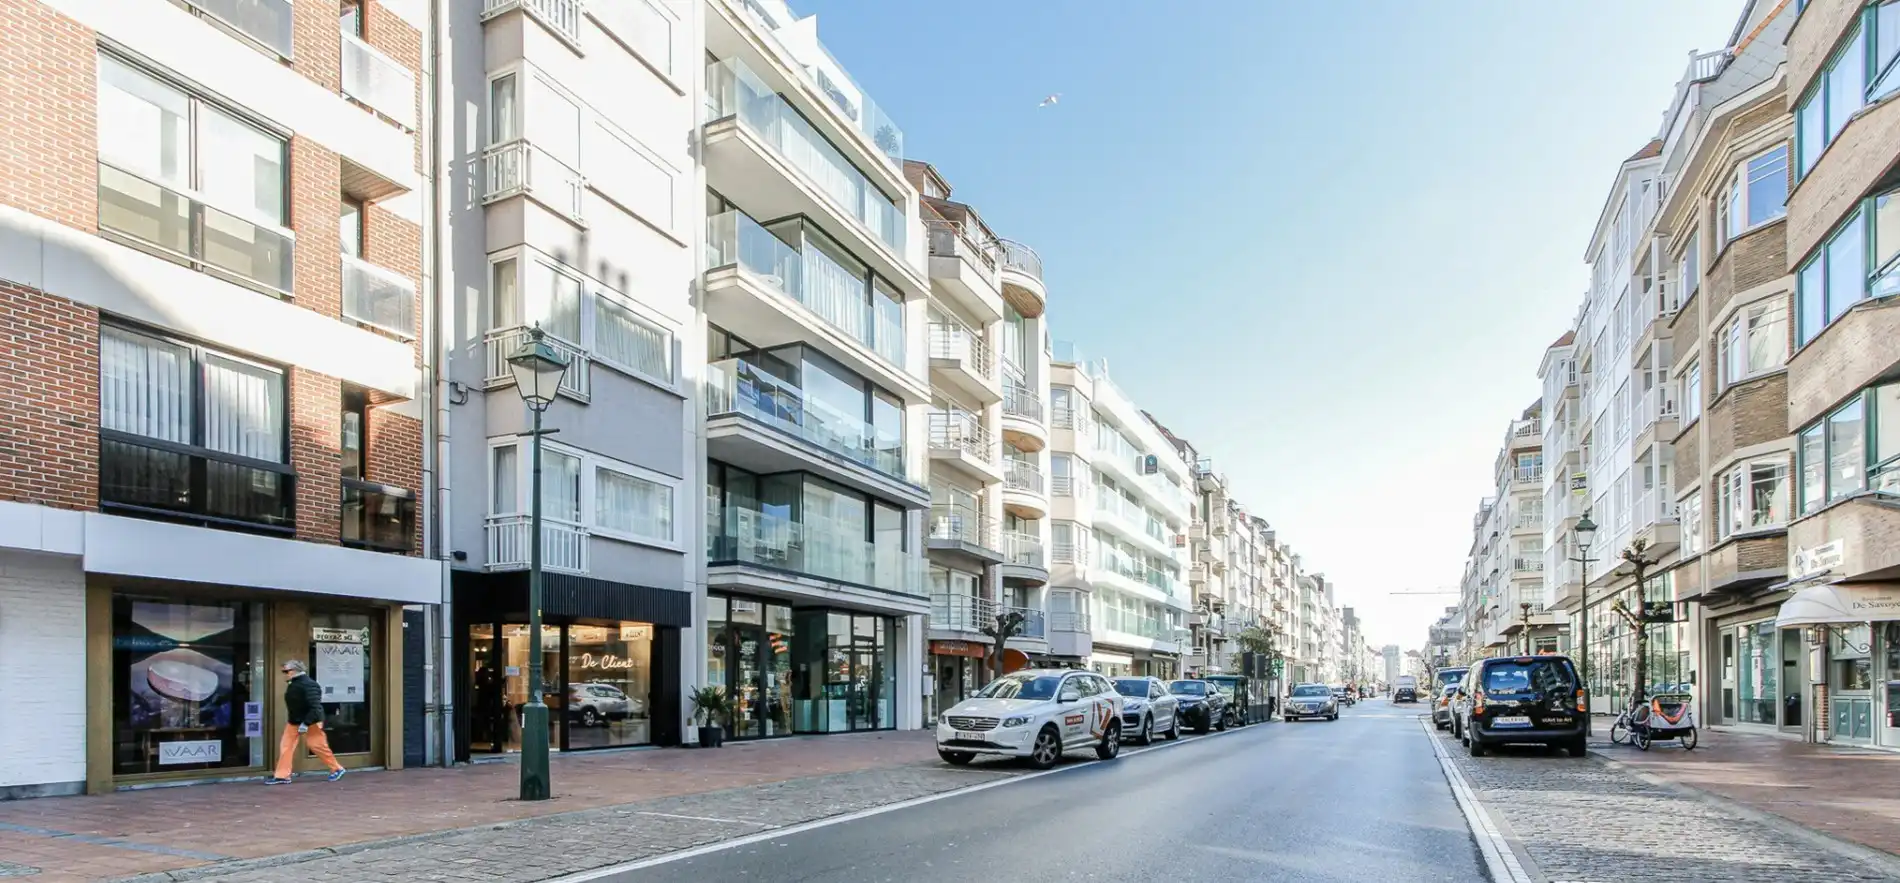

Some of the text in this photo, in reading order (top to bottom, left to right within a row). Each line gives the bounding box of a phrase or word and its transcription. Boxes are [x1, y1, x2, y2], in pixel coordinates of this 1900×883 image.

[321, 646, 360, 655] WAAR
[581, 652, 599, 669] De
[601, 654, 634, 669] Client
[164, 744, 218, 757] WAAR
